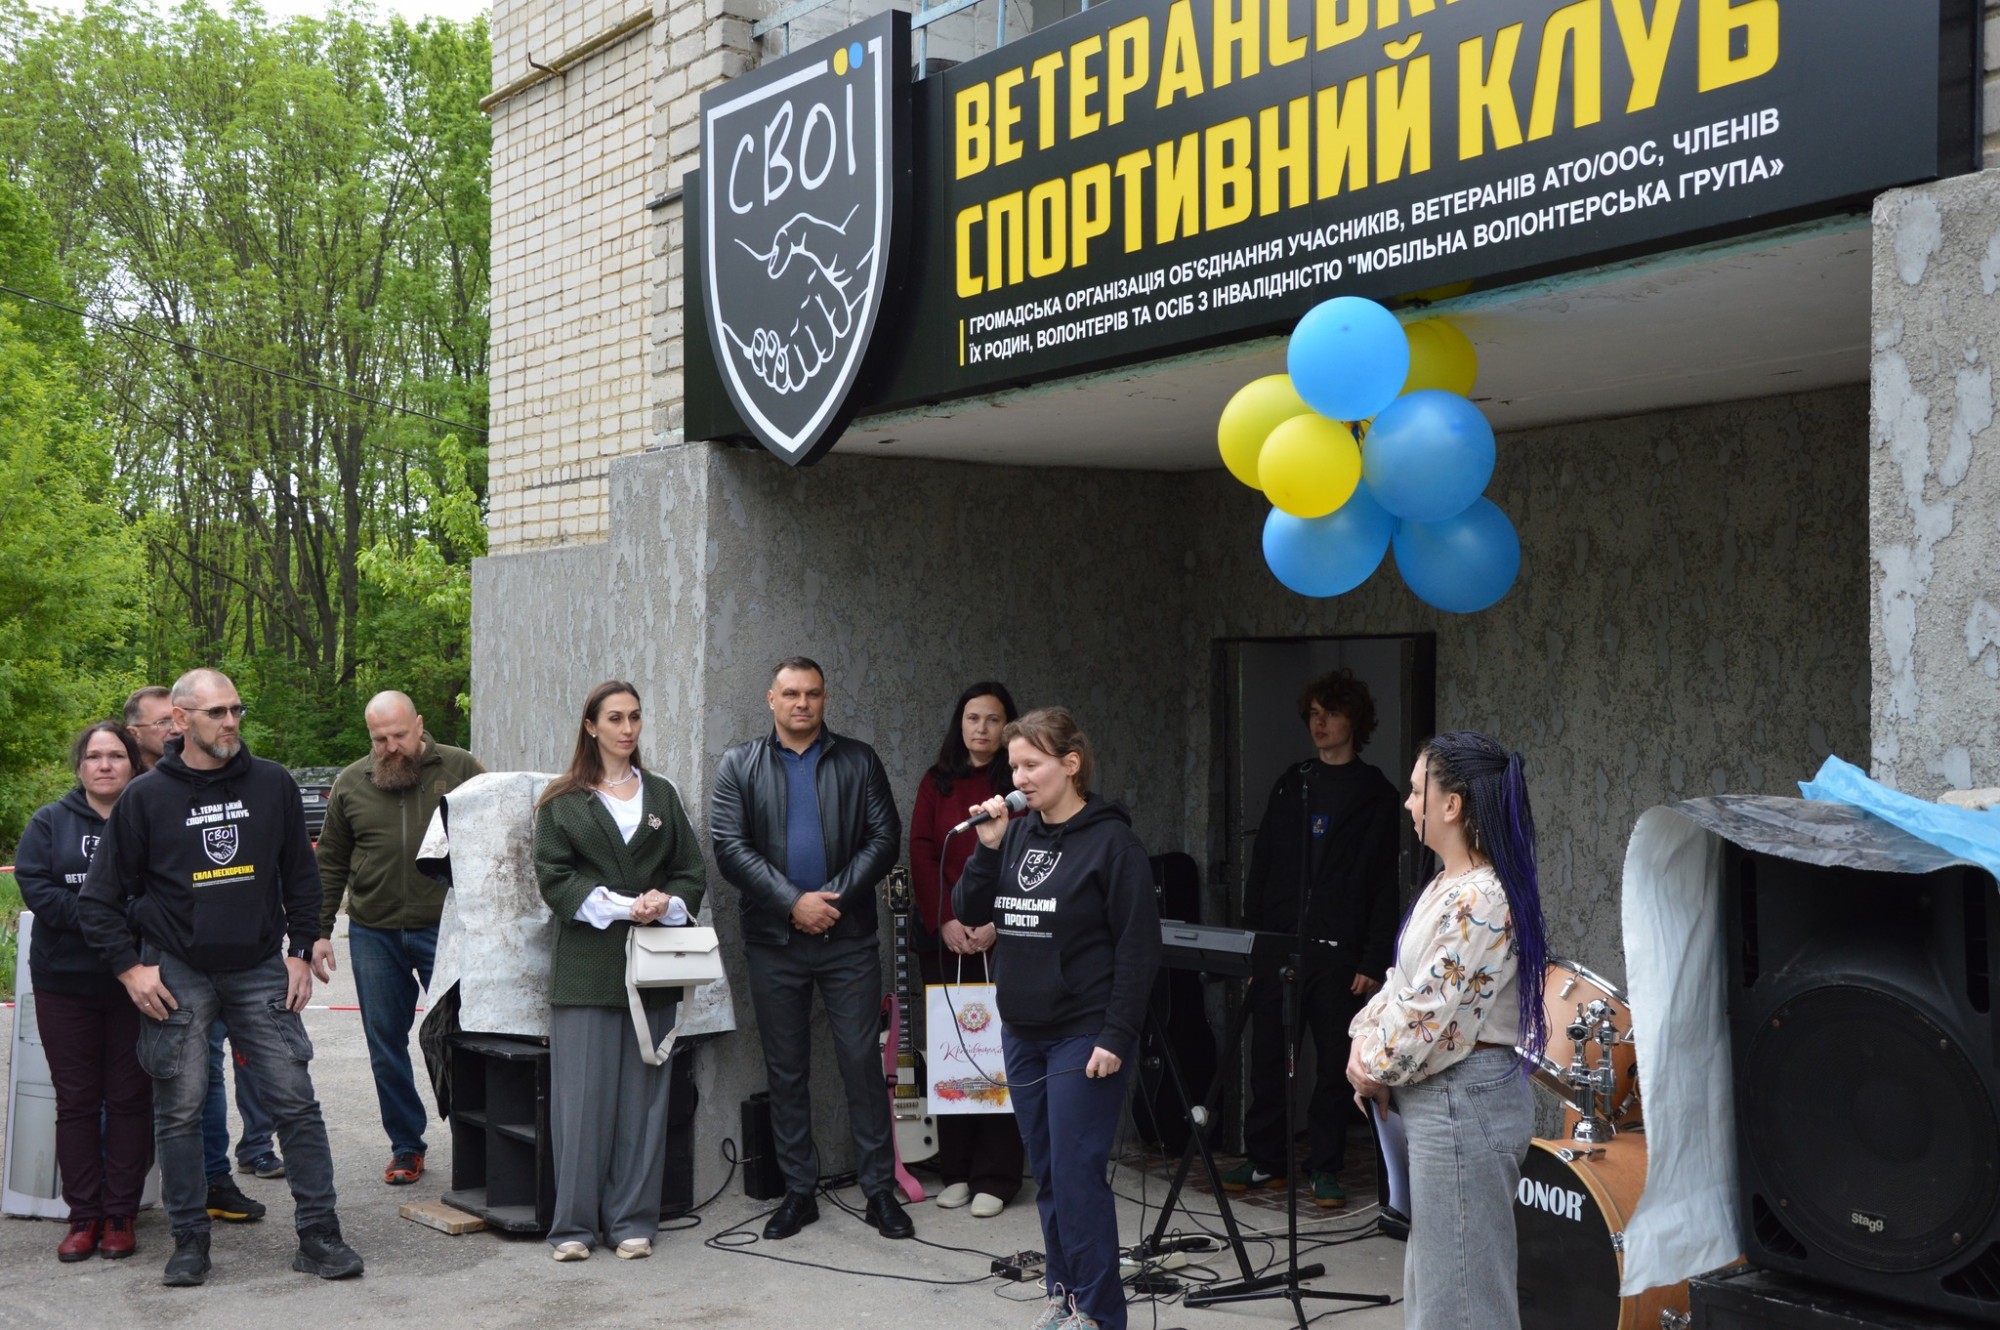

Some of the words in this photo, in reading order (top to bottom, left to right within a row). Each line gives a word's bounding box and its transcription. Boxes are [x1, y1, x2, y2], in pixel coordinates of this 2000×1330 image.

[728, 42, 864, 215] СВОЇ
[955, 0, 1457, 181] ВЕТЕРАНСЬ
[956, 32, 1431, 299] СПОРТИВНИЙ
[1458, 0, 1780, 161] КЛУБ
[969, 296, 1063, 336] ГРОМАДСЬКА
[1065, 268, 1165, 312] ОРГАНІЗАЦІЯ
[1169, 238, 1283, 285] ОБ'ЄДНАННЯ
[1287, 208, 1405, 257] УЧАСНИКІВ,
[1411, 172, 1536, 226] ВЕТЕРАНІВ
[1542, 140, 1664, 192] АТО/ООС,
[1672, 107, 1780, 156] ЧЛЕНІВ
[969, 342, 982, 364] ЇХ
[984, 333, 1034, 361] РОДИН,
[1036, 310, 1129, 349] ВОЛОНТЕРІВ
[1131, 305, 1152, 326] ТА
[1154, 294, 1194, 321] ОСІБ
[1197, 290, 1209, 312] З
[1212, 258, 1343, 309] ІНВАЛІДНІСТЮ
[1347, 229, 1468, 275] "МОБІЛЬНА
[1473, 179, 1672, 248] ВОЛОНТЕРСЬКА
[1679, 155, 1785, 199] ГРУПА»
[193, 870, 213, 881] СИЛА
[1004, 912, 1039, 927] ПРОСТІР
[1515, 1177, 1583, 1222] ONOR
[1851, 1212, 1884, 1232] Stagg
